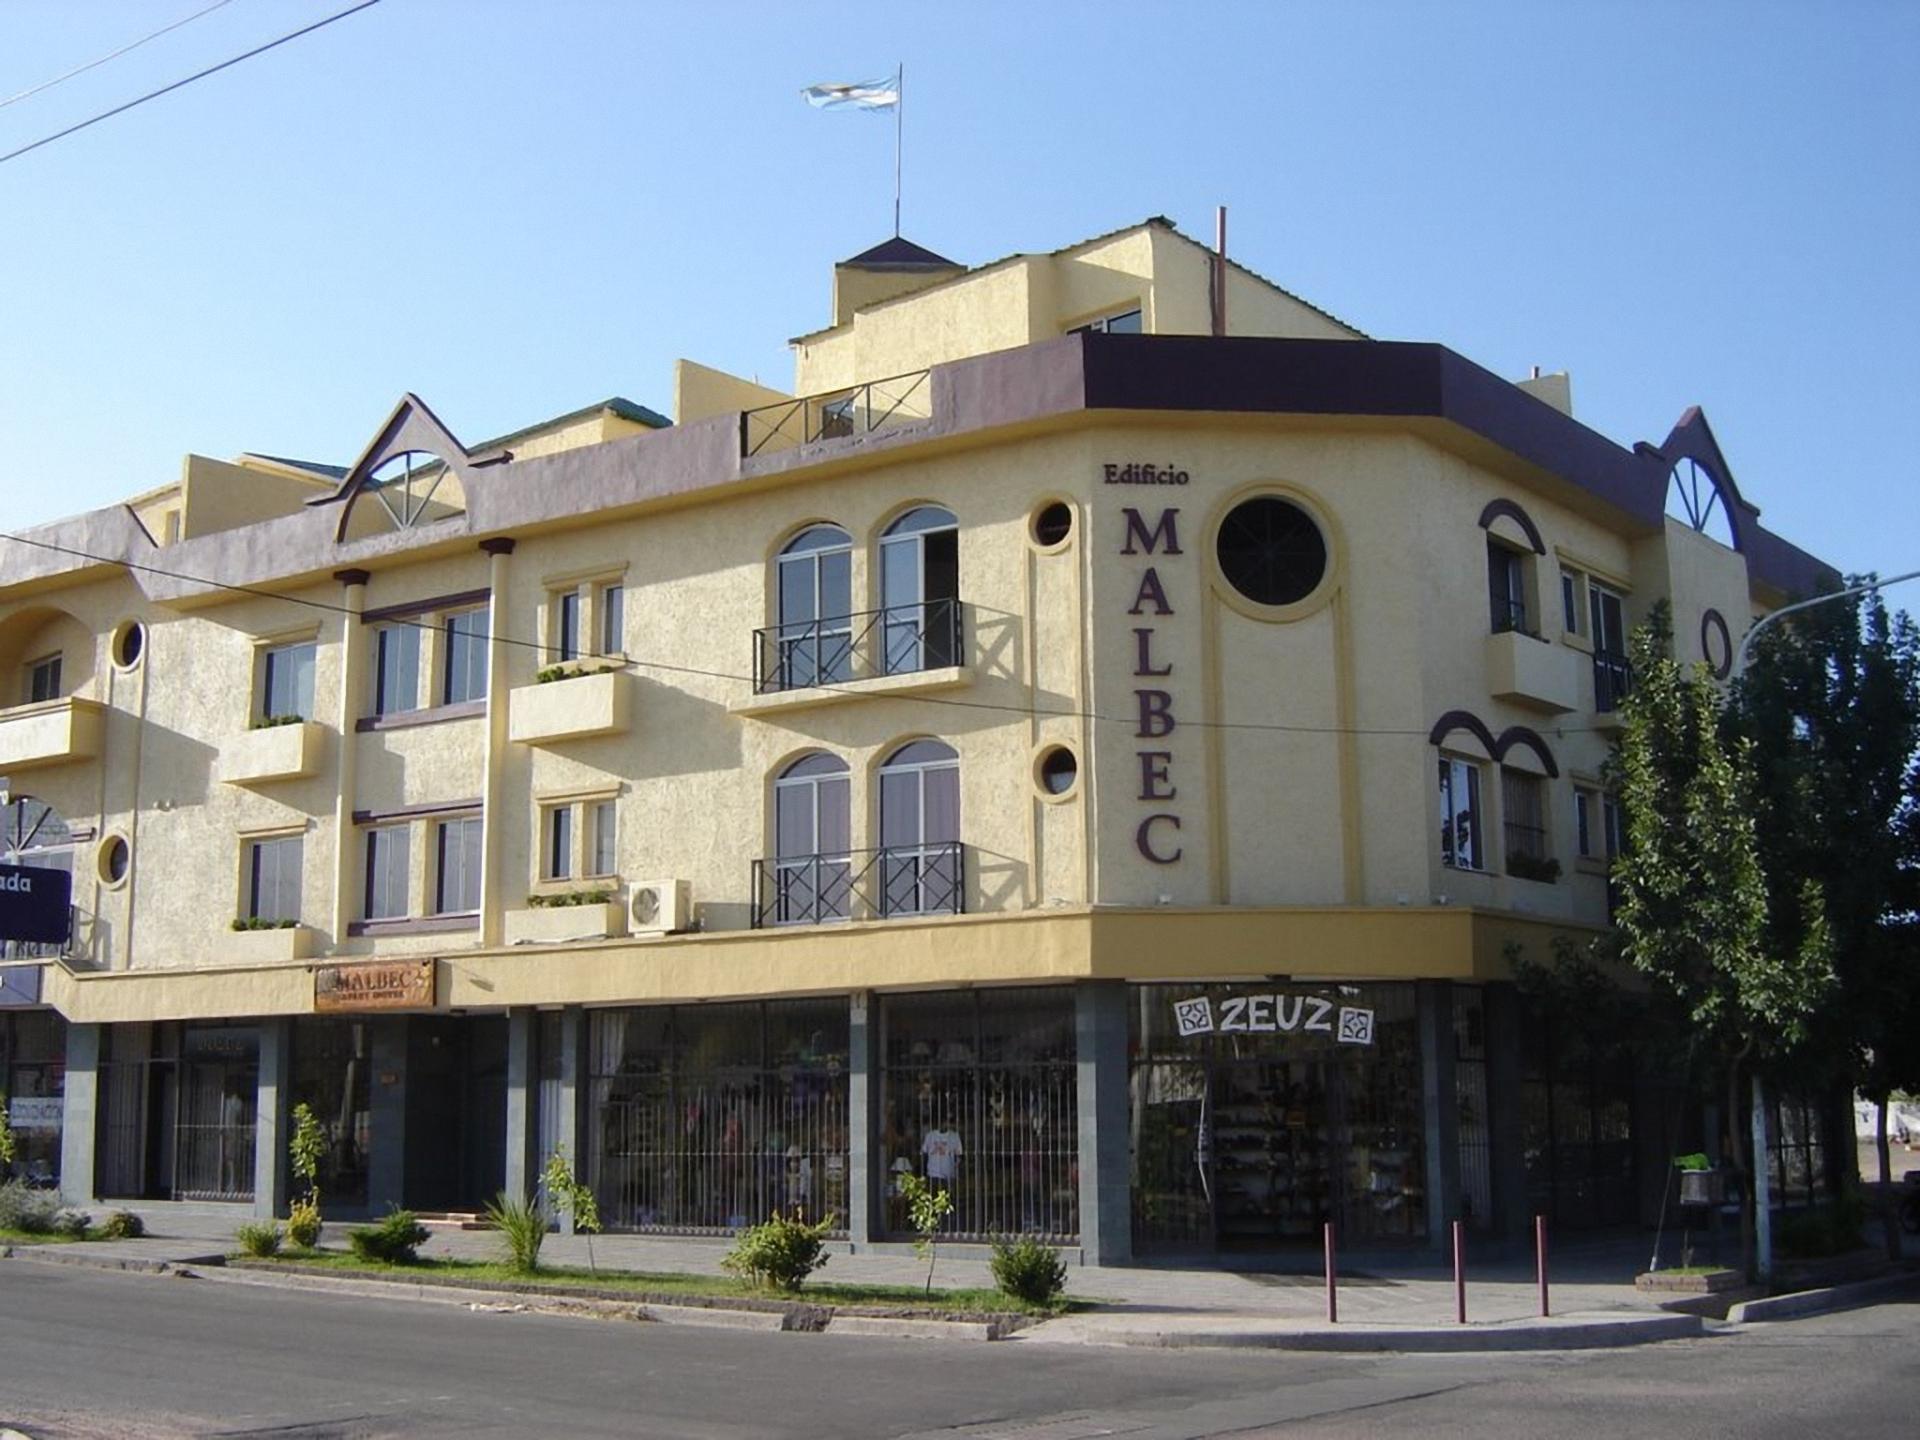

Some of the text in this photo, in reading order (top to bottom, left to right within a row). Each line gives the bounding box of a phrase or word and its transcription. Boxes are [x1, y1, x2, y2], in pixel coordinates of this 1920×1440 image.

[1104, 463, 1189, 485] Edificio
[1120, 507, 1184, 864] MALBEC
[1220, 994, 1333, 1031] ZEUZ
